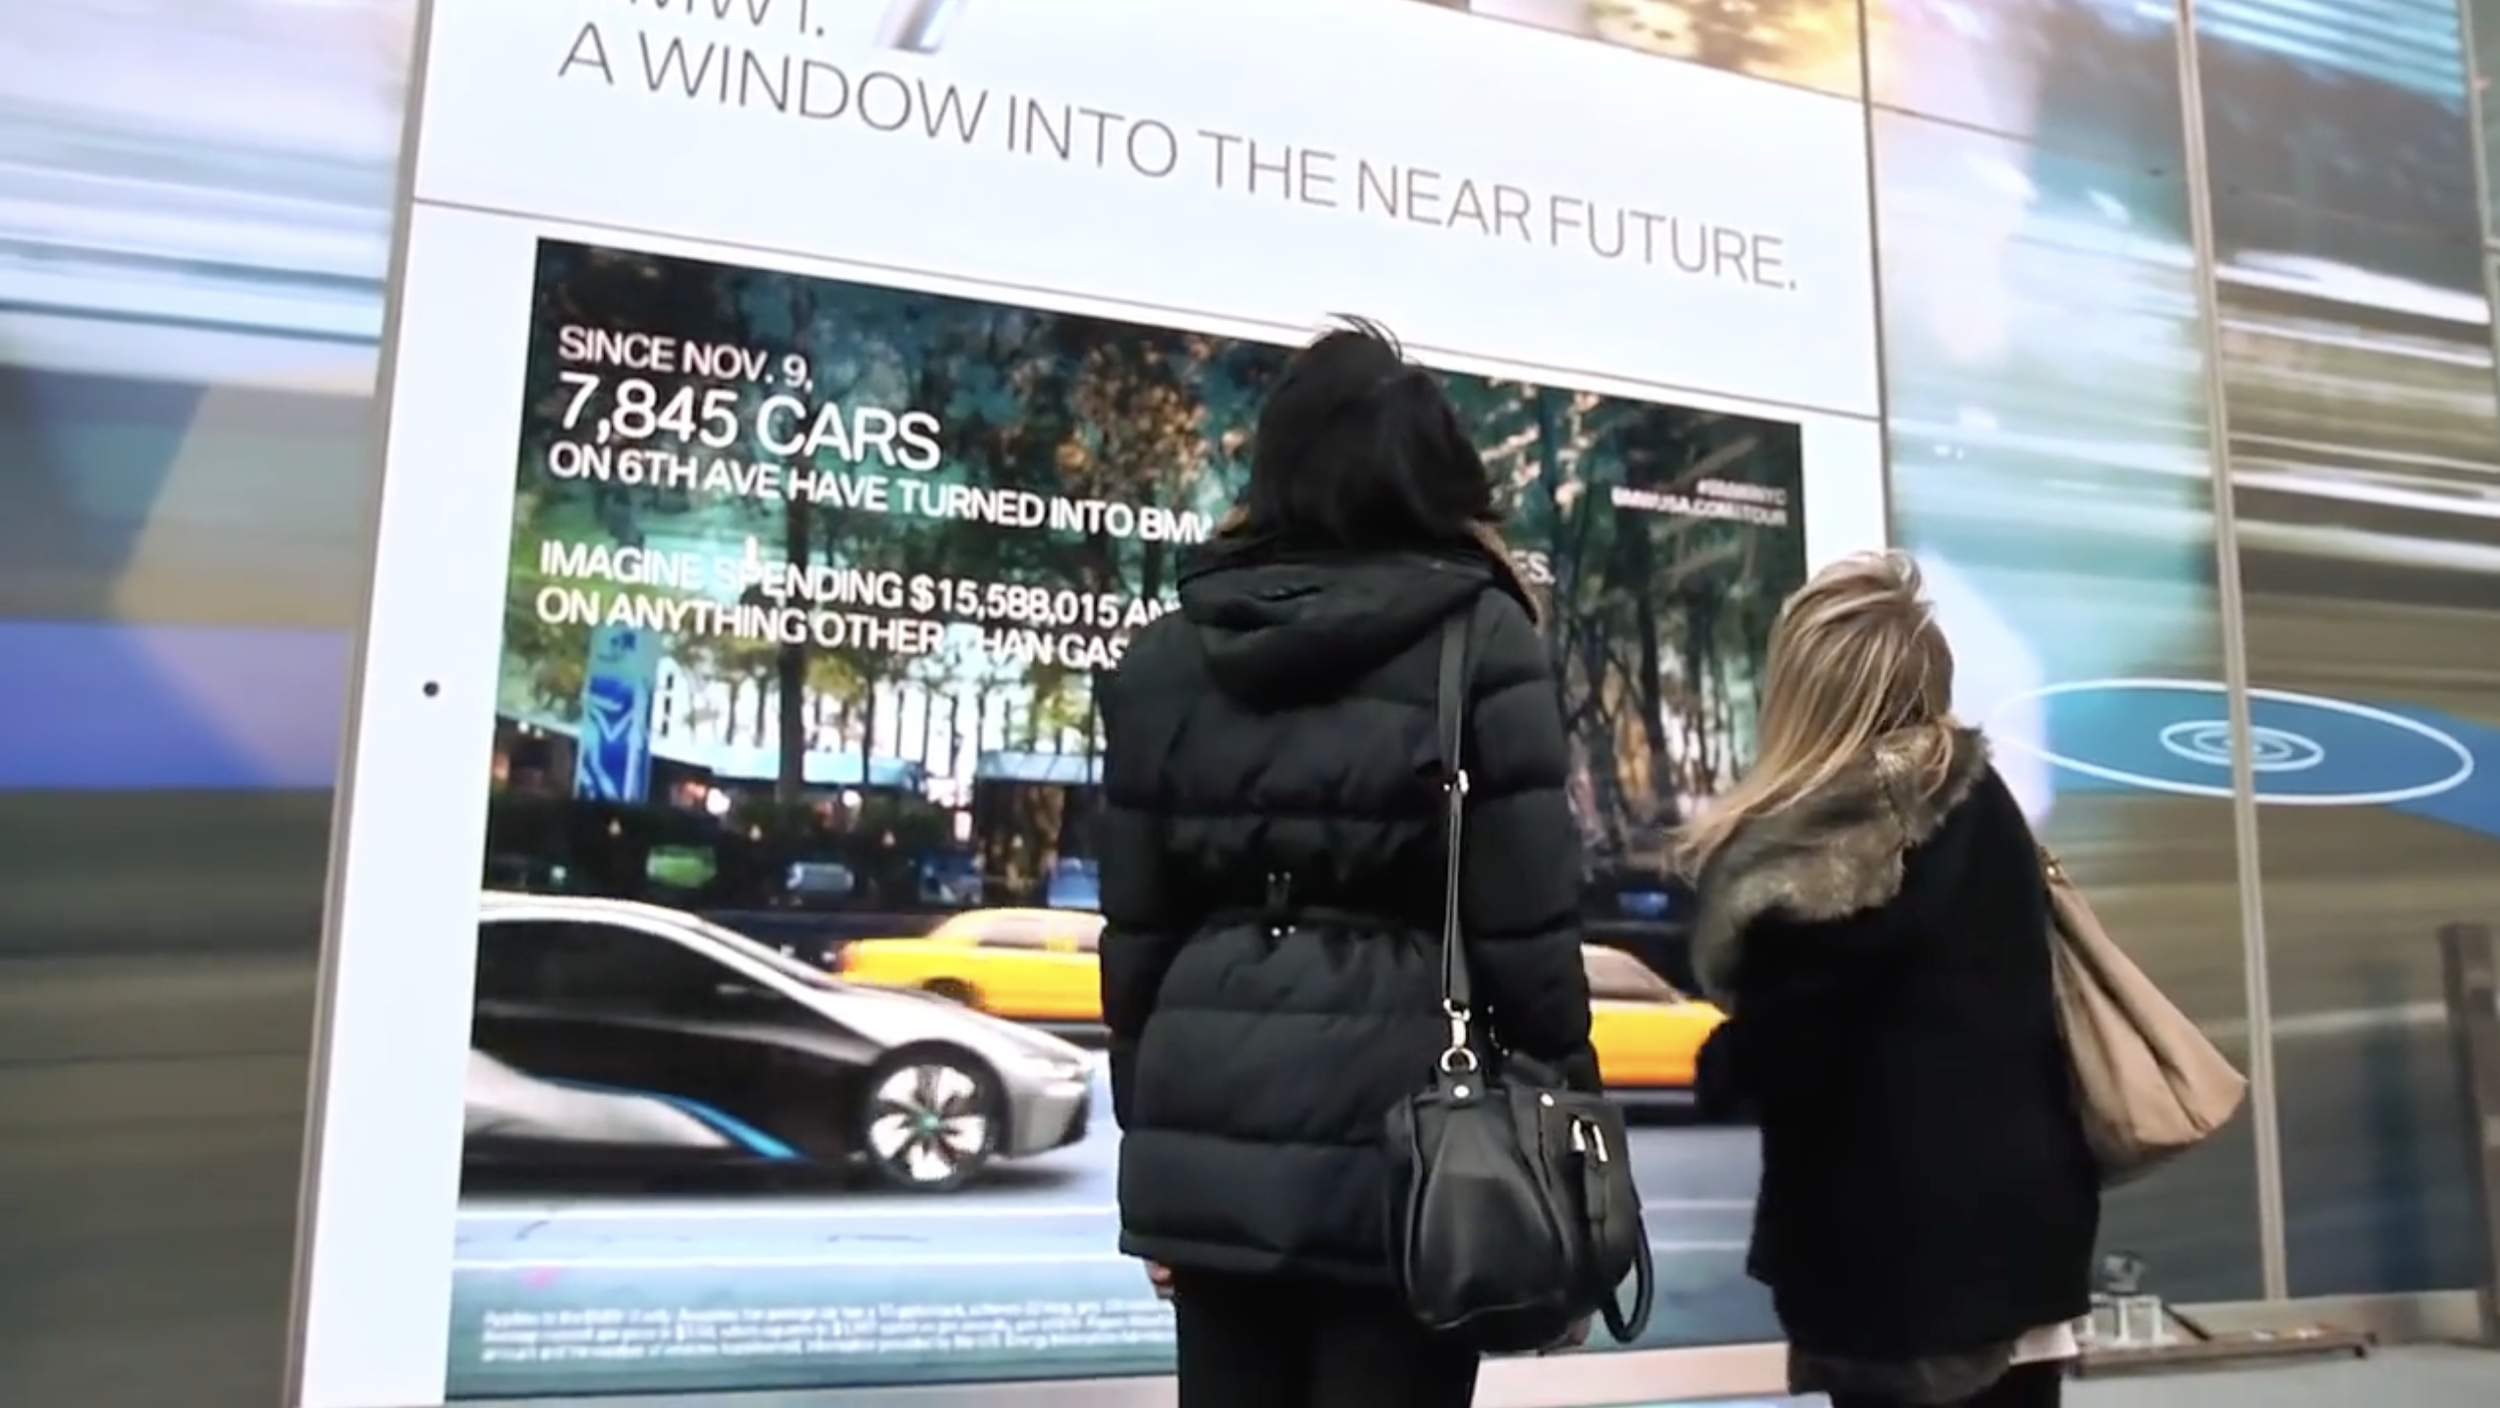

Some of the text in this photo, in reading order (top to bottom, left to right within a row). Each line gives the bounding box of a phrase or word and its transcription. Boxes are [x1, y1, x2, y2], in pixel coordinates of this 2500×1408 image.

[558, 22, 1797, 291] A WINDOW INTO THE NEAR FUTURE.
[558, 324, 814, 392] SINCE NOV. 9,
[558, 371, 942, 471] 7,845 CARS
[549, 441, 610, 482] ON
[616, 450, 698, 490] 6TH
[703, 458, 782, 500] AVE
[787, 469, 889, 512] HAVE
[896, 478, 1044, 528] TURNED
[1049, 496, 1135, 539] INTO
[535, 585, 601, 628] ON
[605, 592, 806, 645] ANYTHING
[814, 610, 944, 655] OTHER
[946, 619, 1053, 666] THAN
[540, 539, 704, 591] IMAGINE
[712, 555, 902, 611] SPENDING
[908, 573, 1121, 629] $15,588,015
